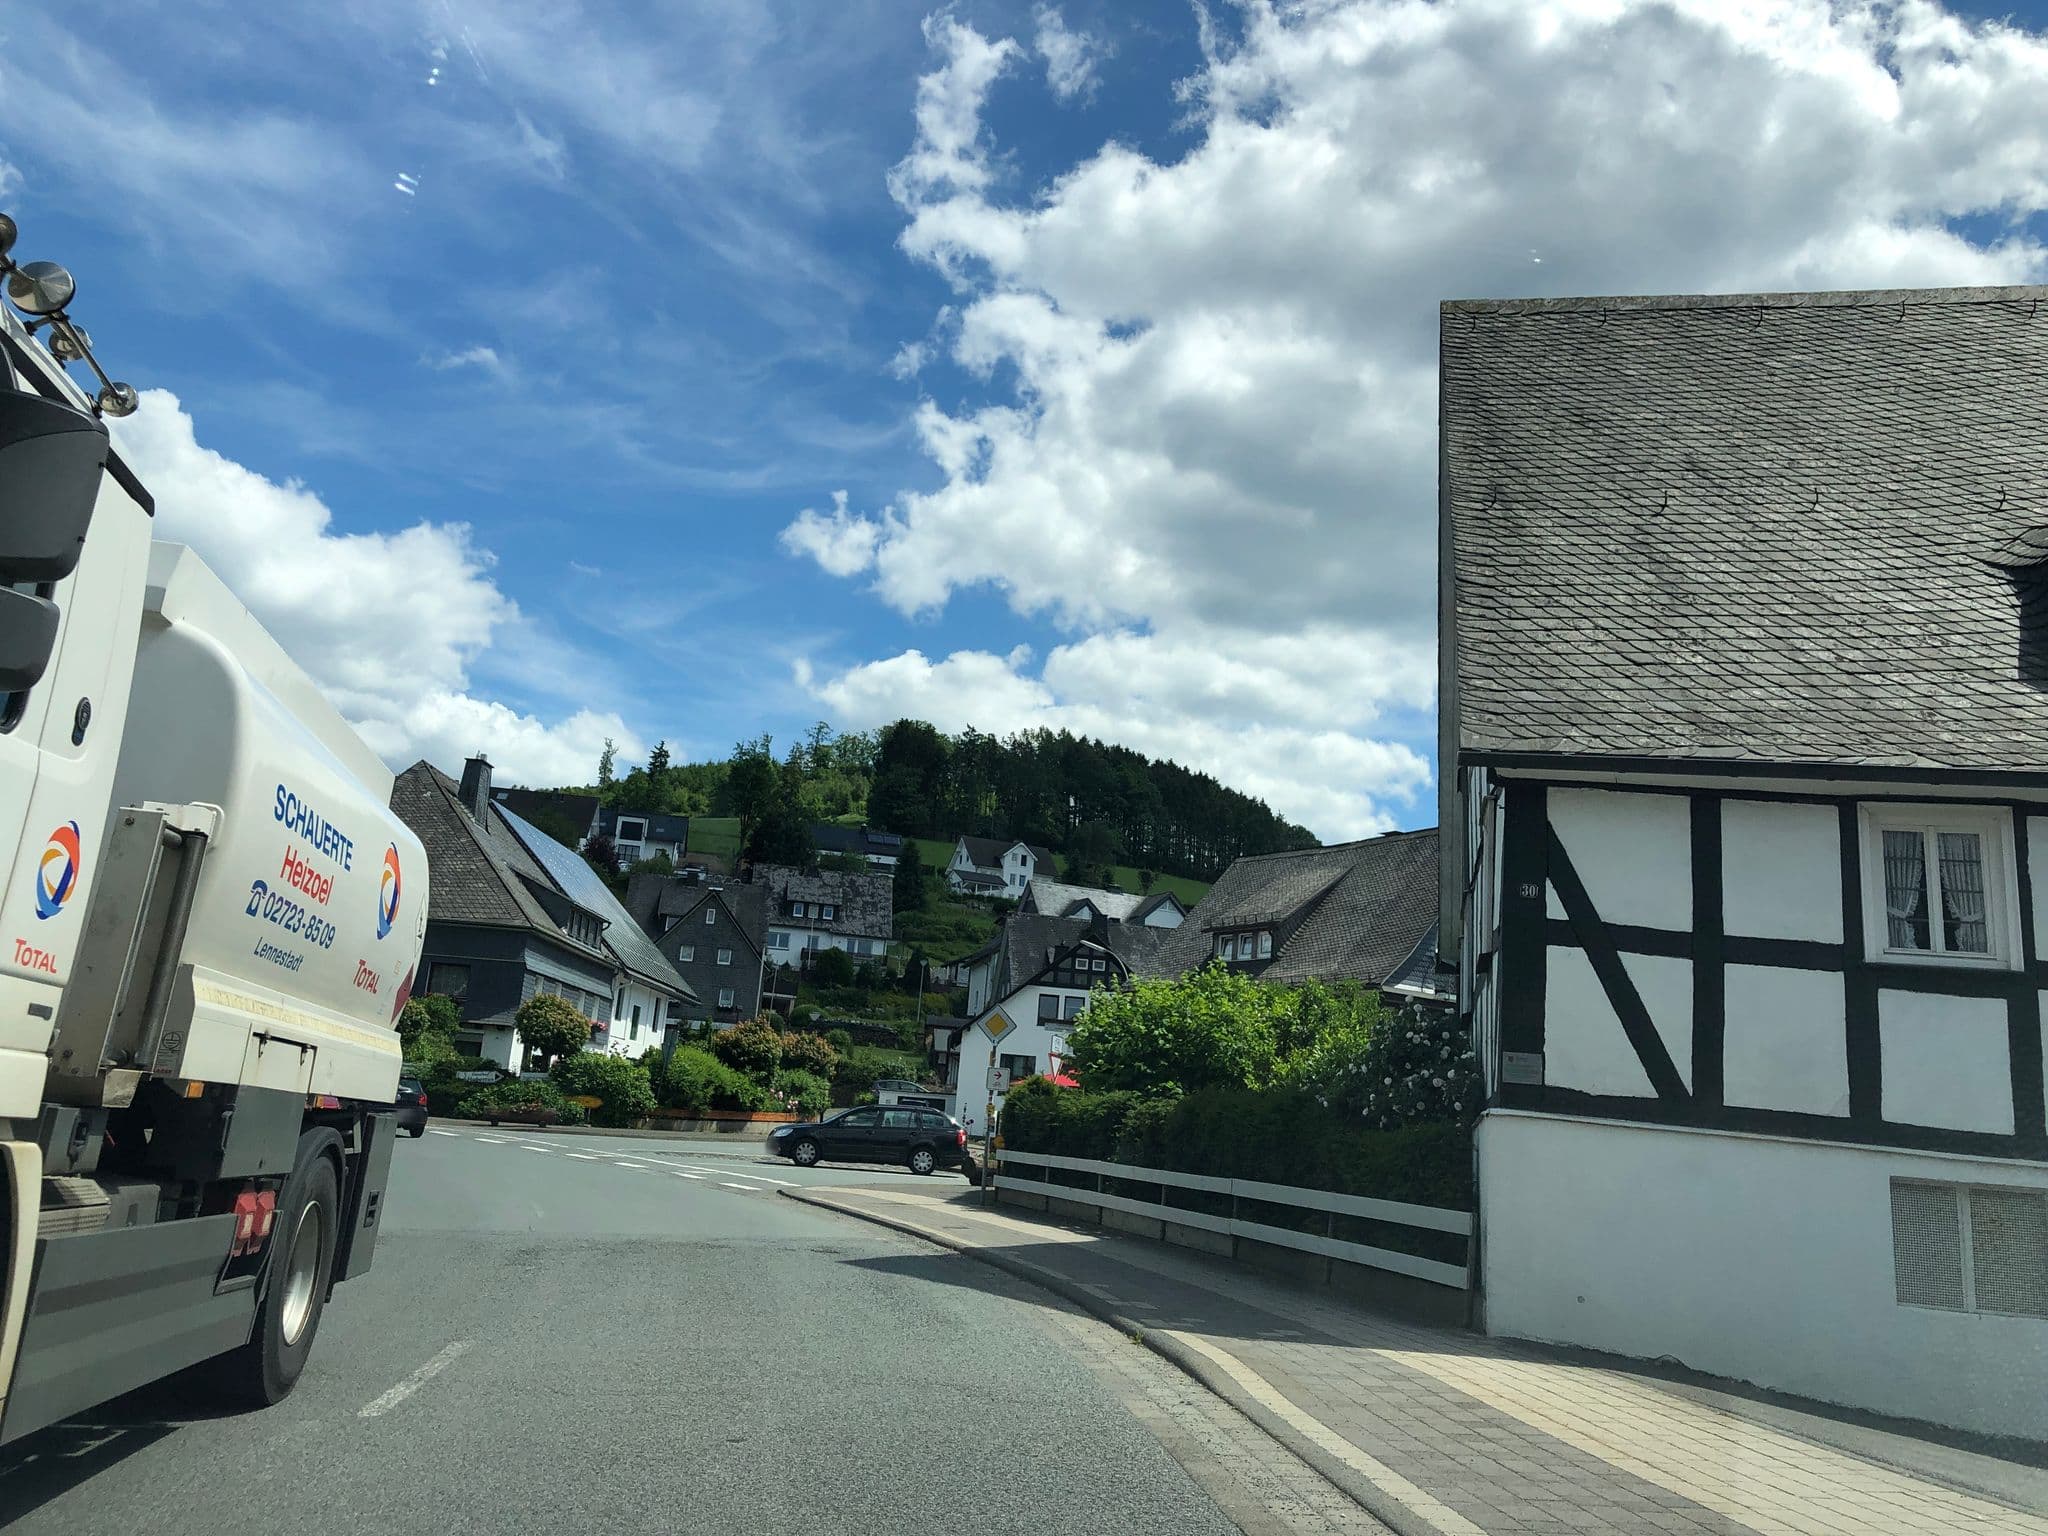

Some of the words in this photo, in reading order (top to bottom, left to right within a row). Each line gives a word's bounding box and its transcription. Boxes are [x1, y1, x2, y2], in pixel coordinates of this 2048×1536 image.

[274, 783, 354, 873] SCHAUERTE
[280, 844, 334, 906] Heizoel
[1521, 884, 1537, 897] 30
[263, 891, 336, 949] 02723-8509
[15, 938, 57, 974] TOTAL
[253, 936, 304, 973] Lennestadt
[353, 958, 380, 994] TOTAL
